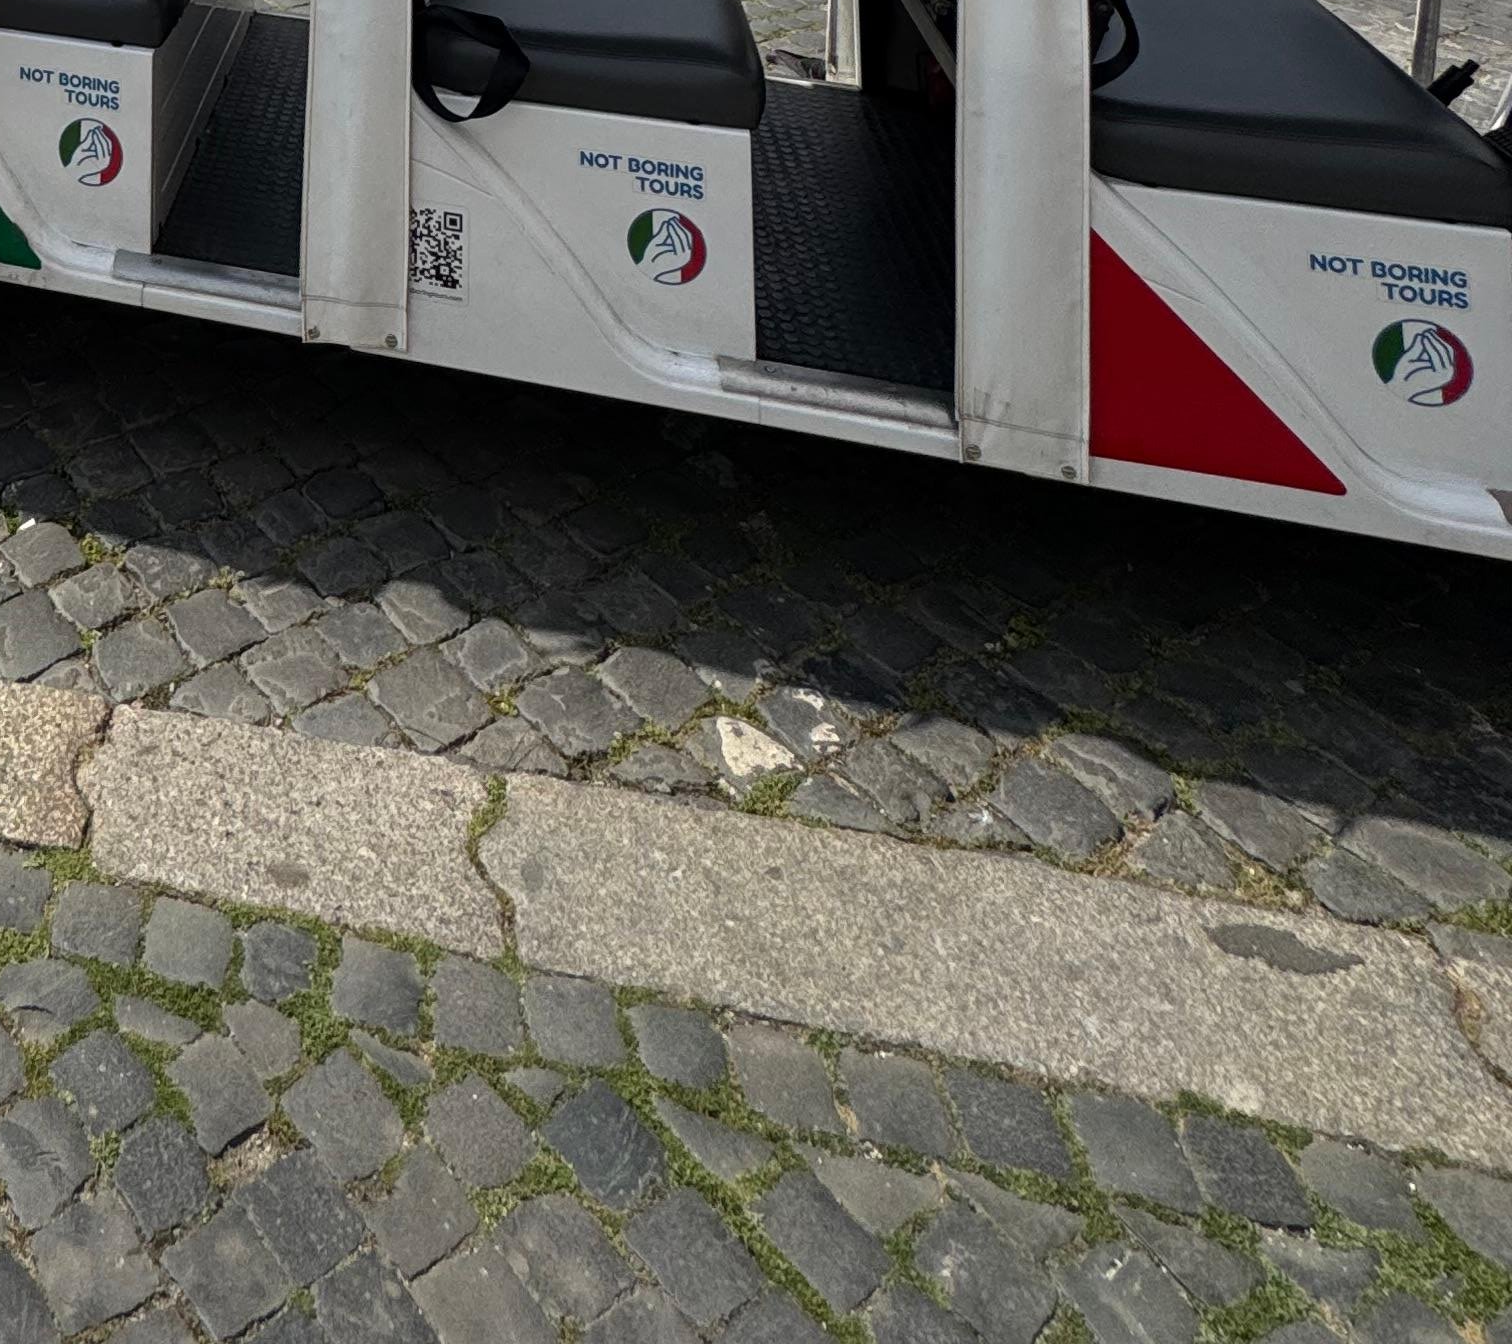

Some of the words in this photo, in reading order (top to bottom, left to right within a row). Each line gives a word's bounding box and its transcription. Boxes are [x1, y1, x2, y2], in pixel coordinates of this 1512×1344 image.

[19, 66, 55, 84] NOT
[58, 72, 120, 94] BORING
[64, 88, 120, 111] TOURS
[580, 150, 623, 170] NOT
[627, 157, 704, 182] BORING
[635, 175, 704, 200] TOURS
[1309, 253, 1364, 275] NOT
[1370, 260, 1468, 289] BORING
[1381, 282, 1469, 310] TOURS
